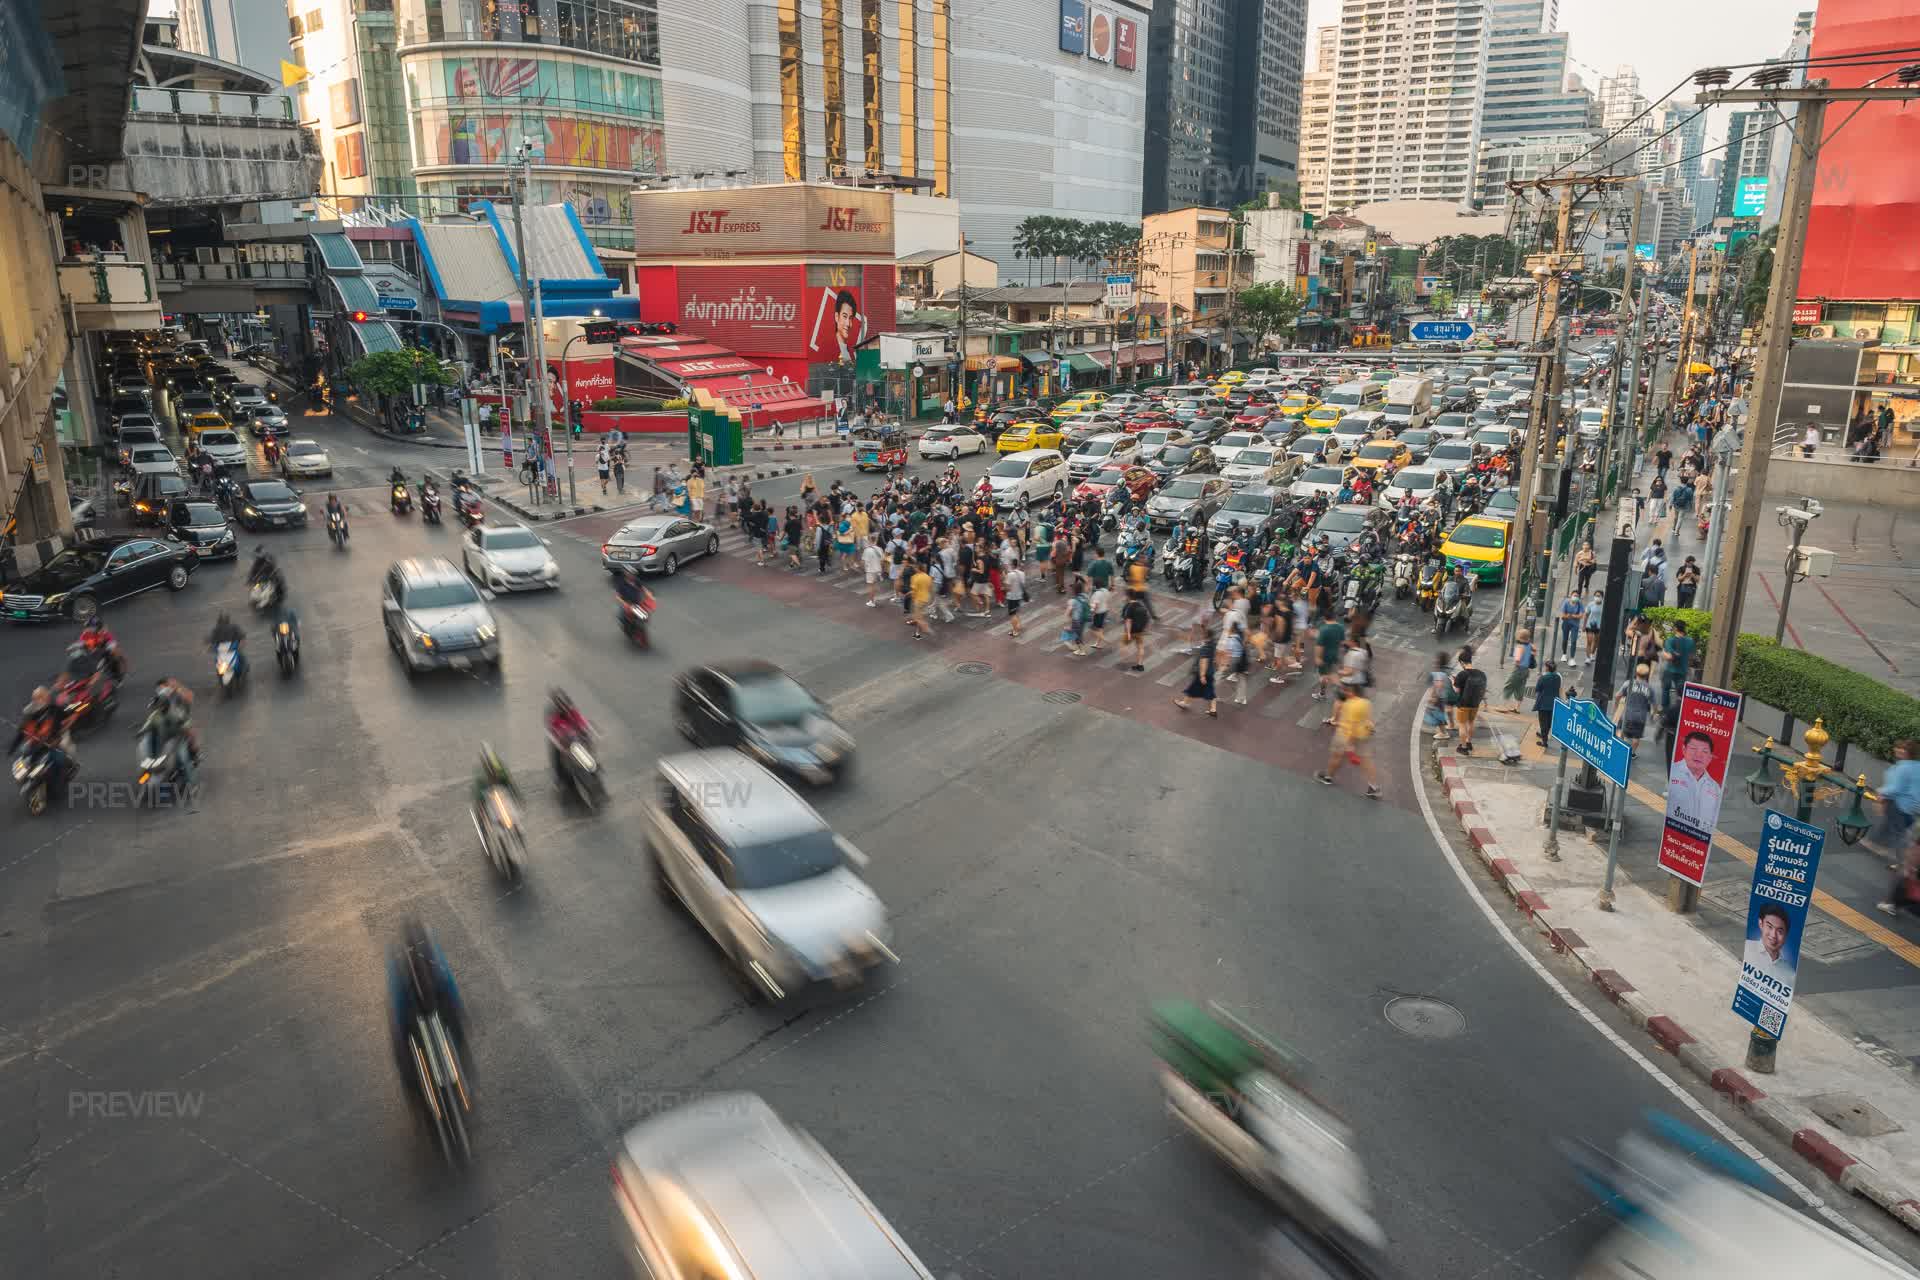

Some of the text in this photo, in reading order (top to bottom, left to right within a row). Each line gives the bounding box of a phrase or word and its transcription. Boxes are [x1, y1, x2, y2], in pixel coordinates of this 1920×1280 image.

[681, 210, 761, 235] J&T EXPRESS
[819, 206, 882, 233] J&T EXPRESS
[684, 286, 796, 327] ส่งทุกที่ทั่วไทย
[1701, 691, 1736, 708] เพื่อไทย
[1693, 707, 1724, 721] คนที่ใช่
[1566, 712, 1613, 759] อโศกมนตรี
[1683, 718, 1730, 737] พรรคที่ชอบ
[1570, 740, 1604, 768] Asok Montri
[1767, 835, 1812, 856] รุ่นใหม่
[1764, 861, 1806, 881] พึ่งพาได้
[1768, 853, 1808, 867] ลุยงานจริง
[1757, 884, 1806, 906] พงศกร
[1743, 961, 1792, 998] พงศกร
